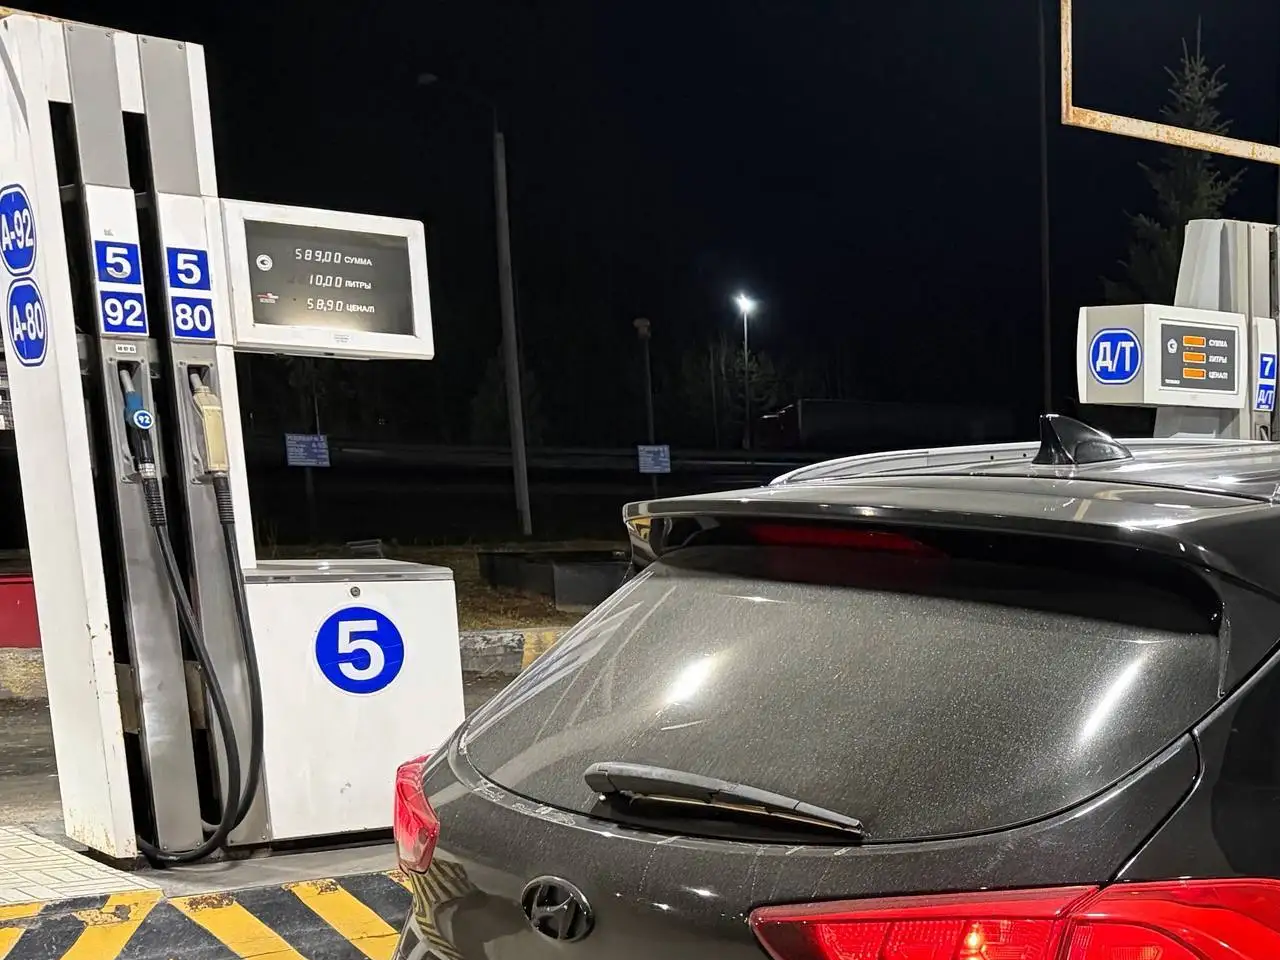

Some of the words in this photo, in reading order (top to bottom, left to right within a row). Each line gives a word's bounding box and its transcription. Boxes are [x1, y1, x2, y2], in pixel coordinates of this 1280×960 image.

[106, 246, 132, 279] 5
[177, 252, 201, 285] 5
[344, 256, 373, 267] СУММА
[310, 274, 343, 288] 10,00
[345, 280, 372, 290] ЛИТРЫ
[104, 297, 144, 327] 92
[175, 303, 212, 332] 80
[307, 298, 343, 312] 58,90
[12, 301, 46, 341] А-80
[1096, 341, 1135, 372] Д/Т
[1262, 356, 1274, 376] 7
[138, 415, 151, 424] 92
[337, 619, 386, 681] 5
